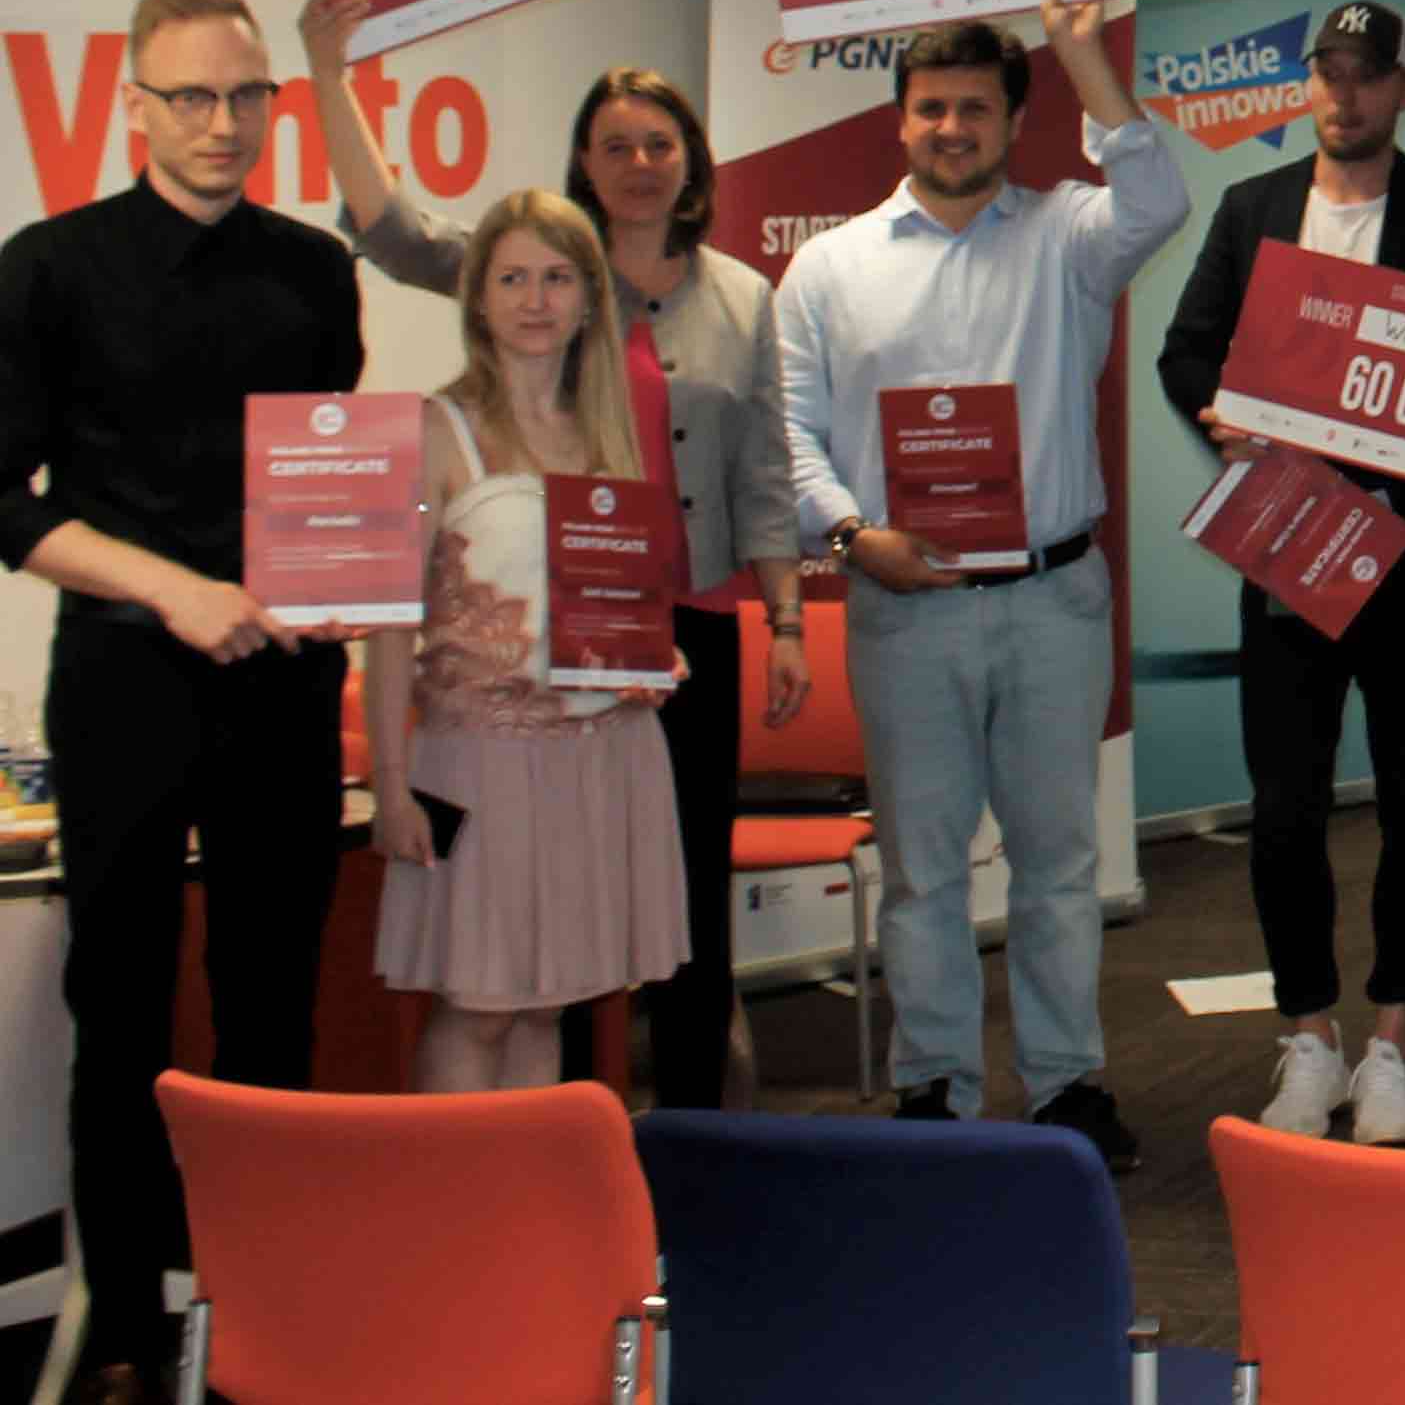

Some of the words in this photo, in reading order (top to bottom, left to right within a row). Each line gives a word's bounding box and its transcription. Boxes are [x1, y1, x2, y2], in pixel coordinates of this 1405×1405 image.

[810, 35, 908, 72] PGNi
[1155, 40, 1281, 94] Polskie
[1299, 294, 1354, 329] WINNER
[1339, 355, 1395, 418] 60
